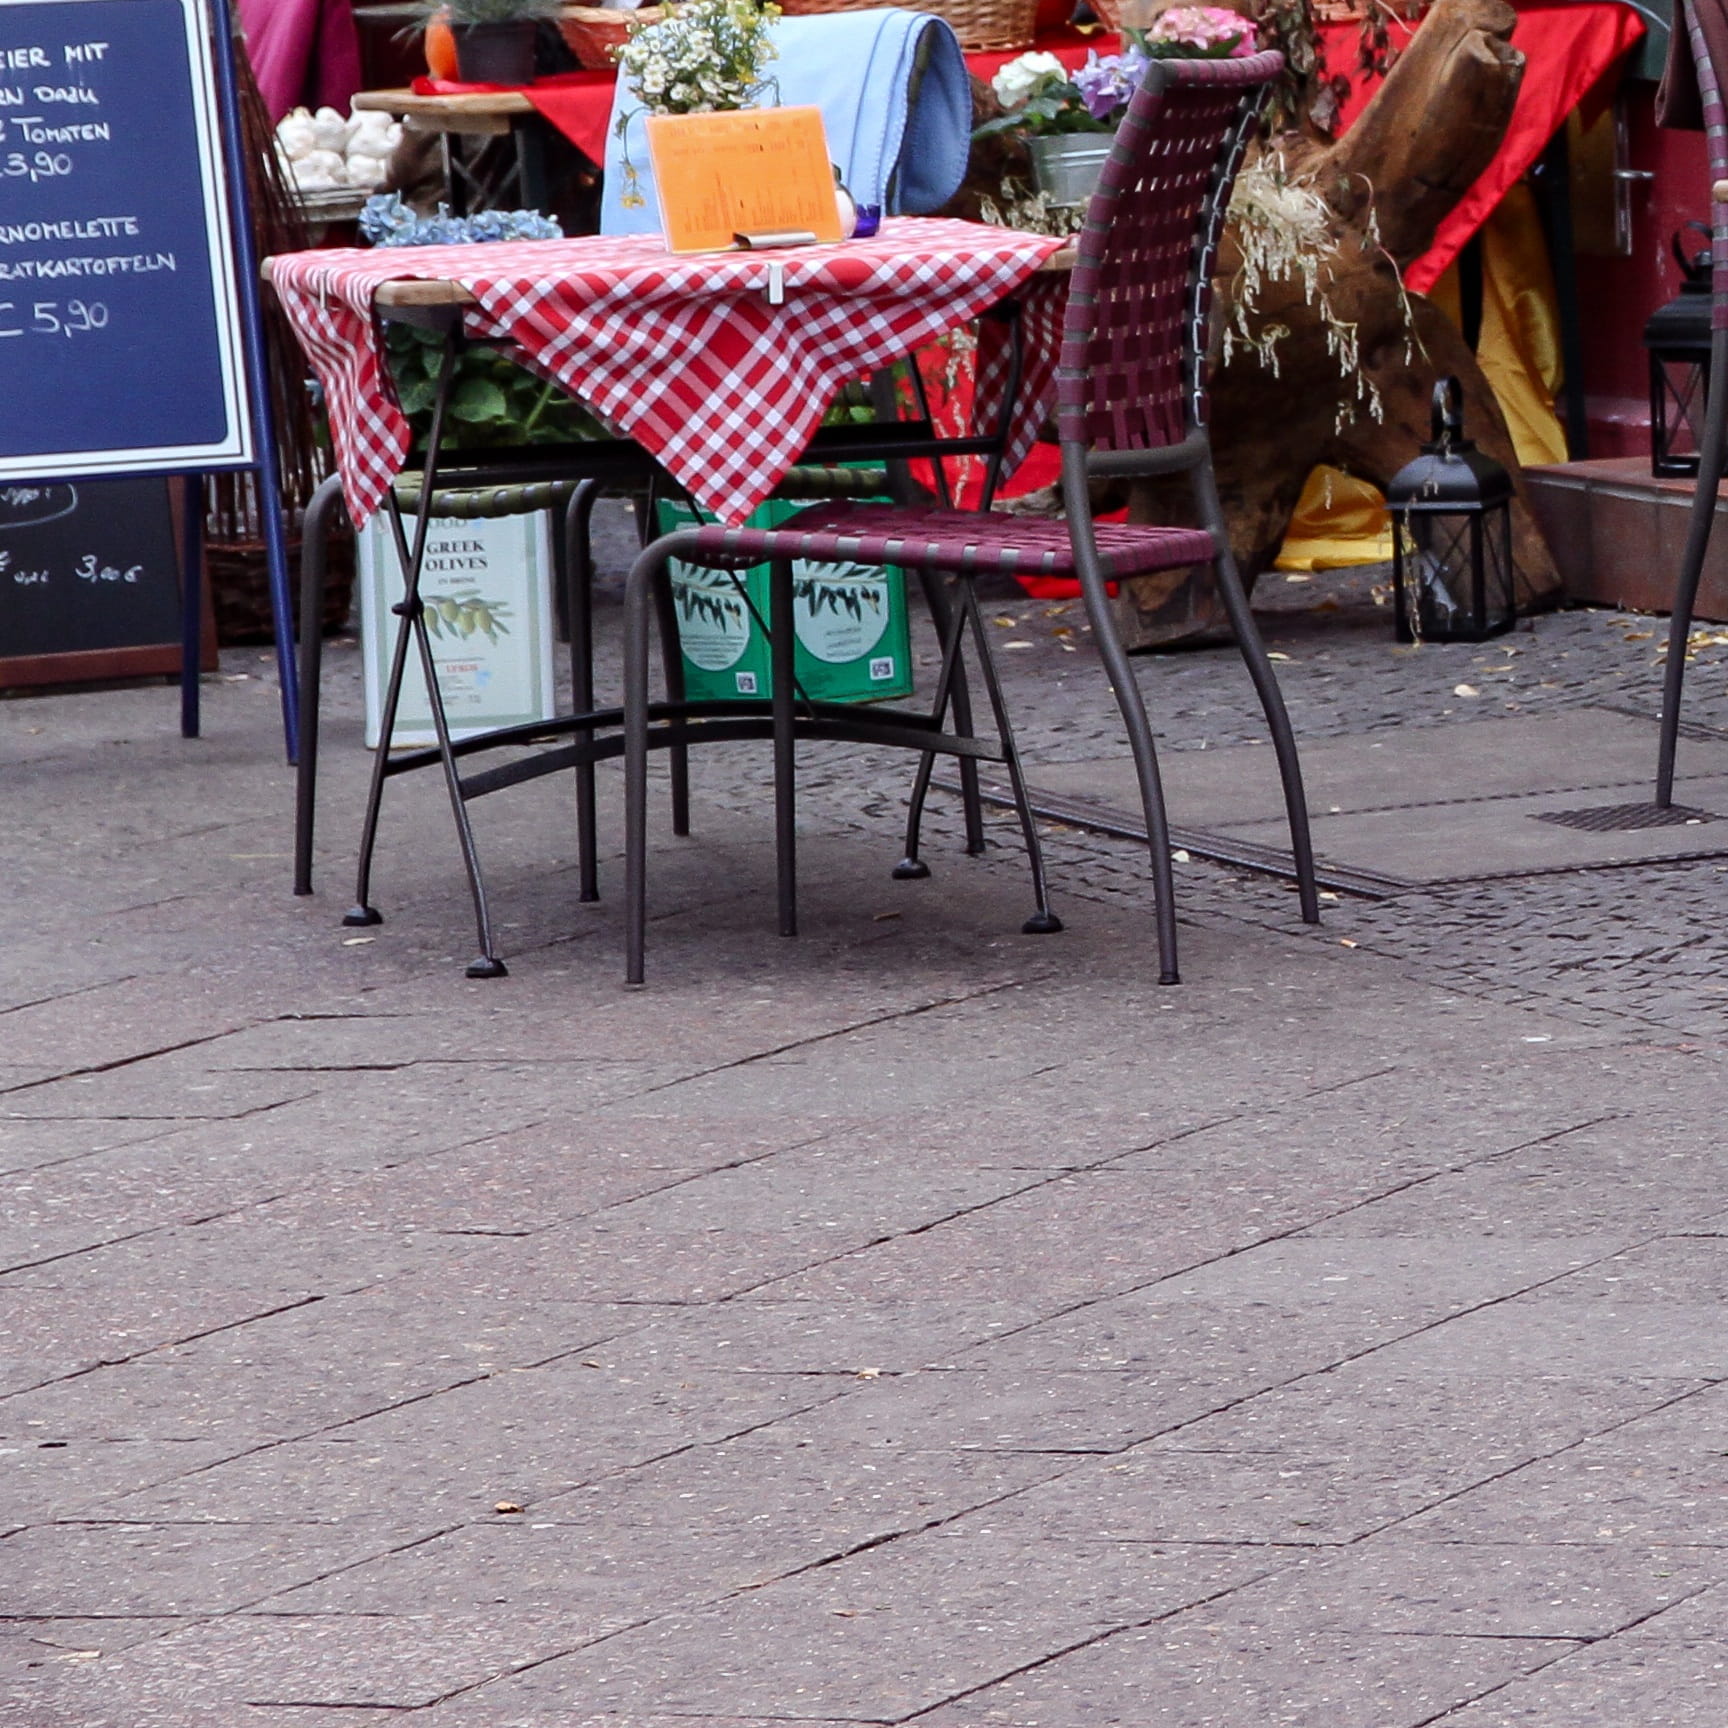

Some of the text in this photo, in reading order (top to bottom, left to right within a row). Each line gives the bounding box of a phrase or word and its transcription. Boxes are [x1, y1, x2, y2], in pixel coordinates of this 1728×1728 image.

[64, 42, 110, 64] MIT
[5, 150, 73, 183] 3,90
[32, 299, 109, 338] 5,90
[426, 539, 486, 556] GREEK
[424, 556, 489, 572] OLIVES
